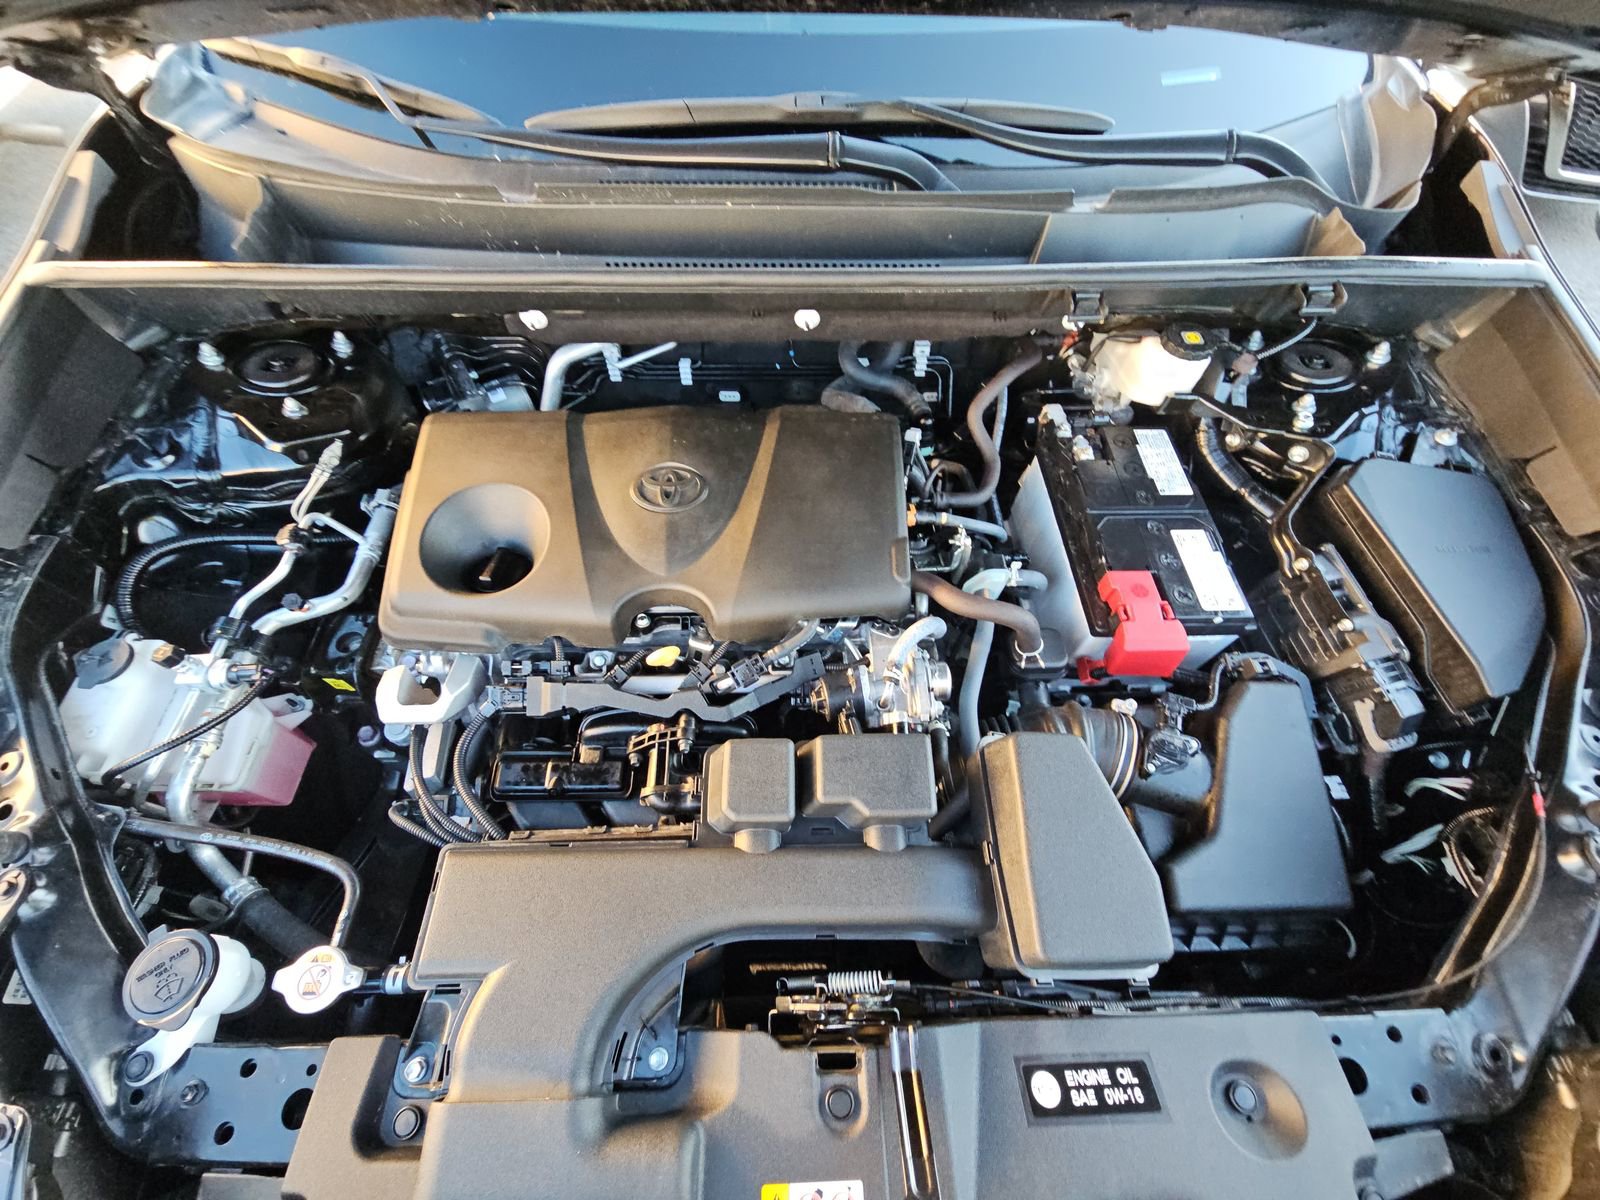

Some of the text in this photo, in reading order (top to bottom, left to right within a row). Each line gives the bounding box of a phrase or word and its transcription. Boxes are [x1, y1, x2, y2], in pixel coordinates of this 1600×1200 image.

[1064, 1067, 1139, 1087] ENGINE OIL
[1070, 1086, 1145, 1107] SAE 0W-16
